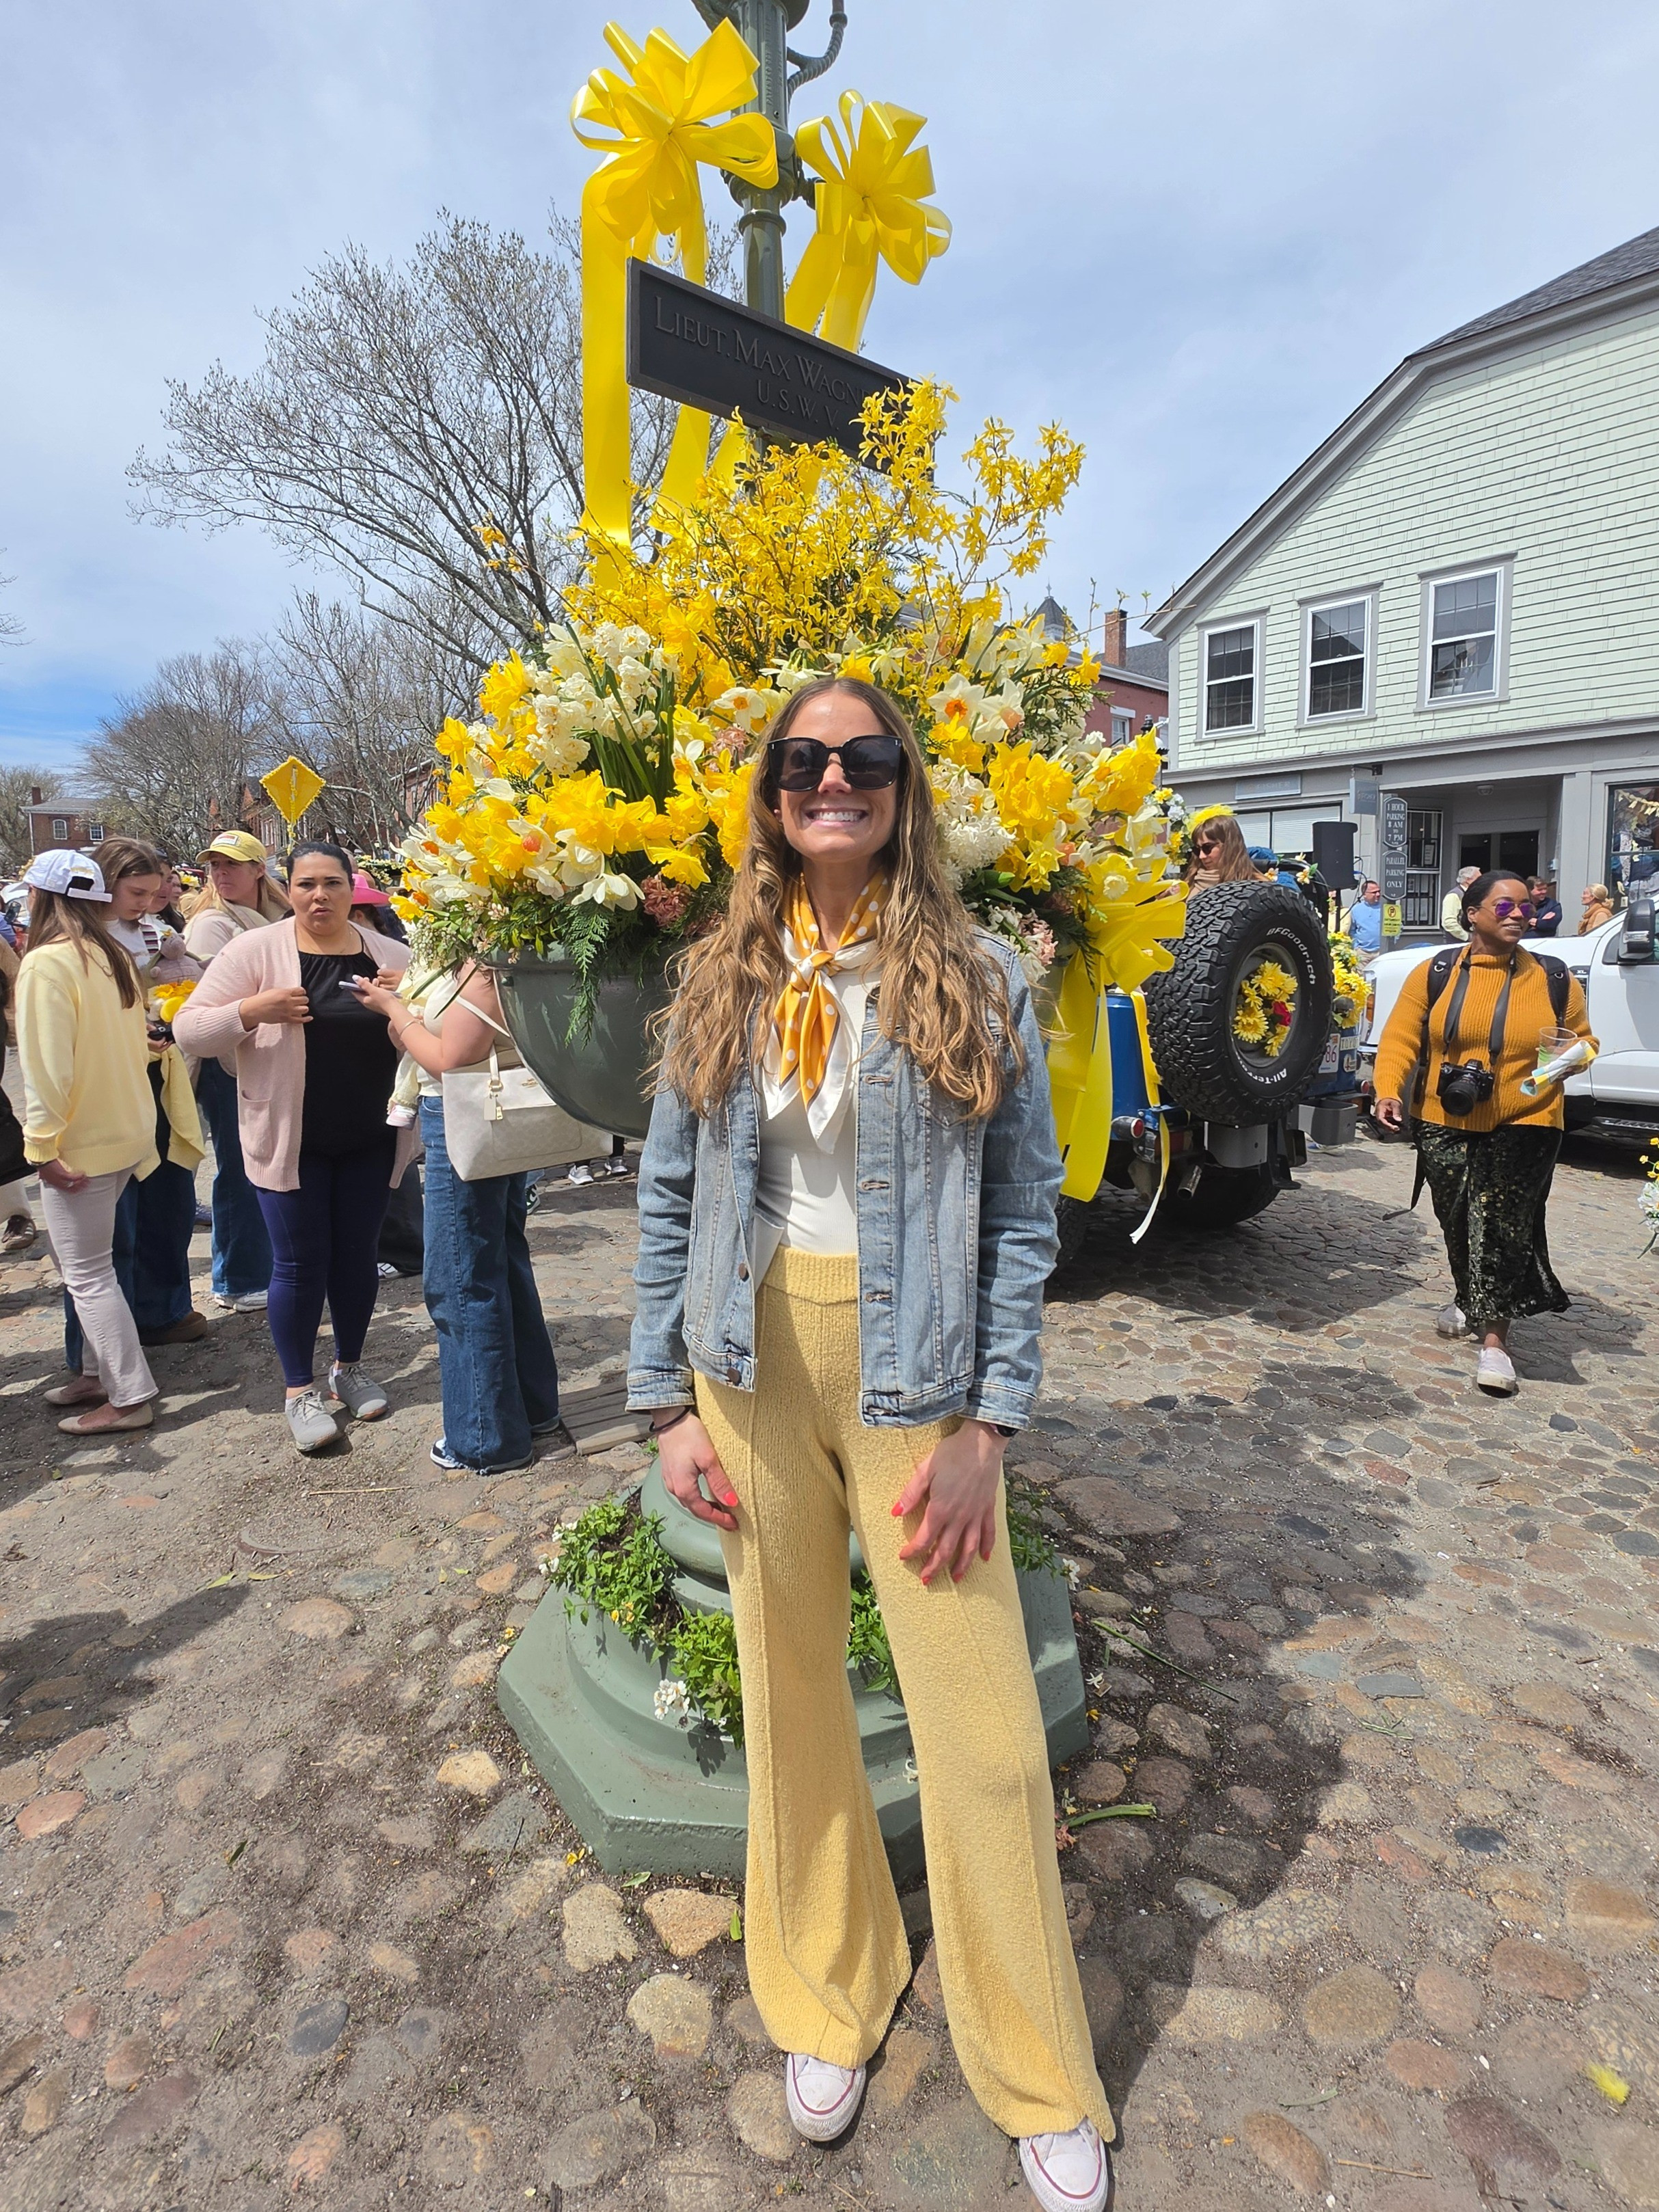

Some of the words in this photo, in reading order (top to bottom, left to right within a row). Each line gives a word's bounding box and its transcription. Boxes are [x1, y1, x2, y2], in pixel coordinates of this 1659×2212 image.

[656, 295, 731, 358] LIEUT.
[733, 328, 791, 381] MAX
[794, 354, 870, 409] WAGN
[1266, 927, 1316, 984] BFGoodrich
[1341, 1036, 1360, 1049] TOYO
